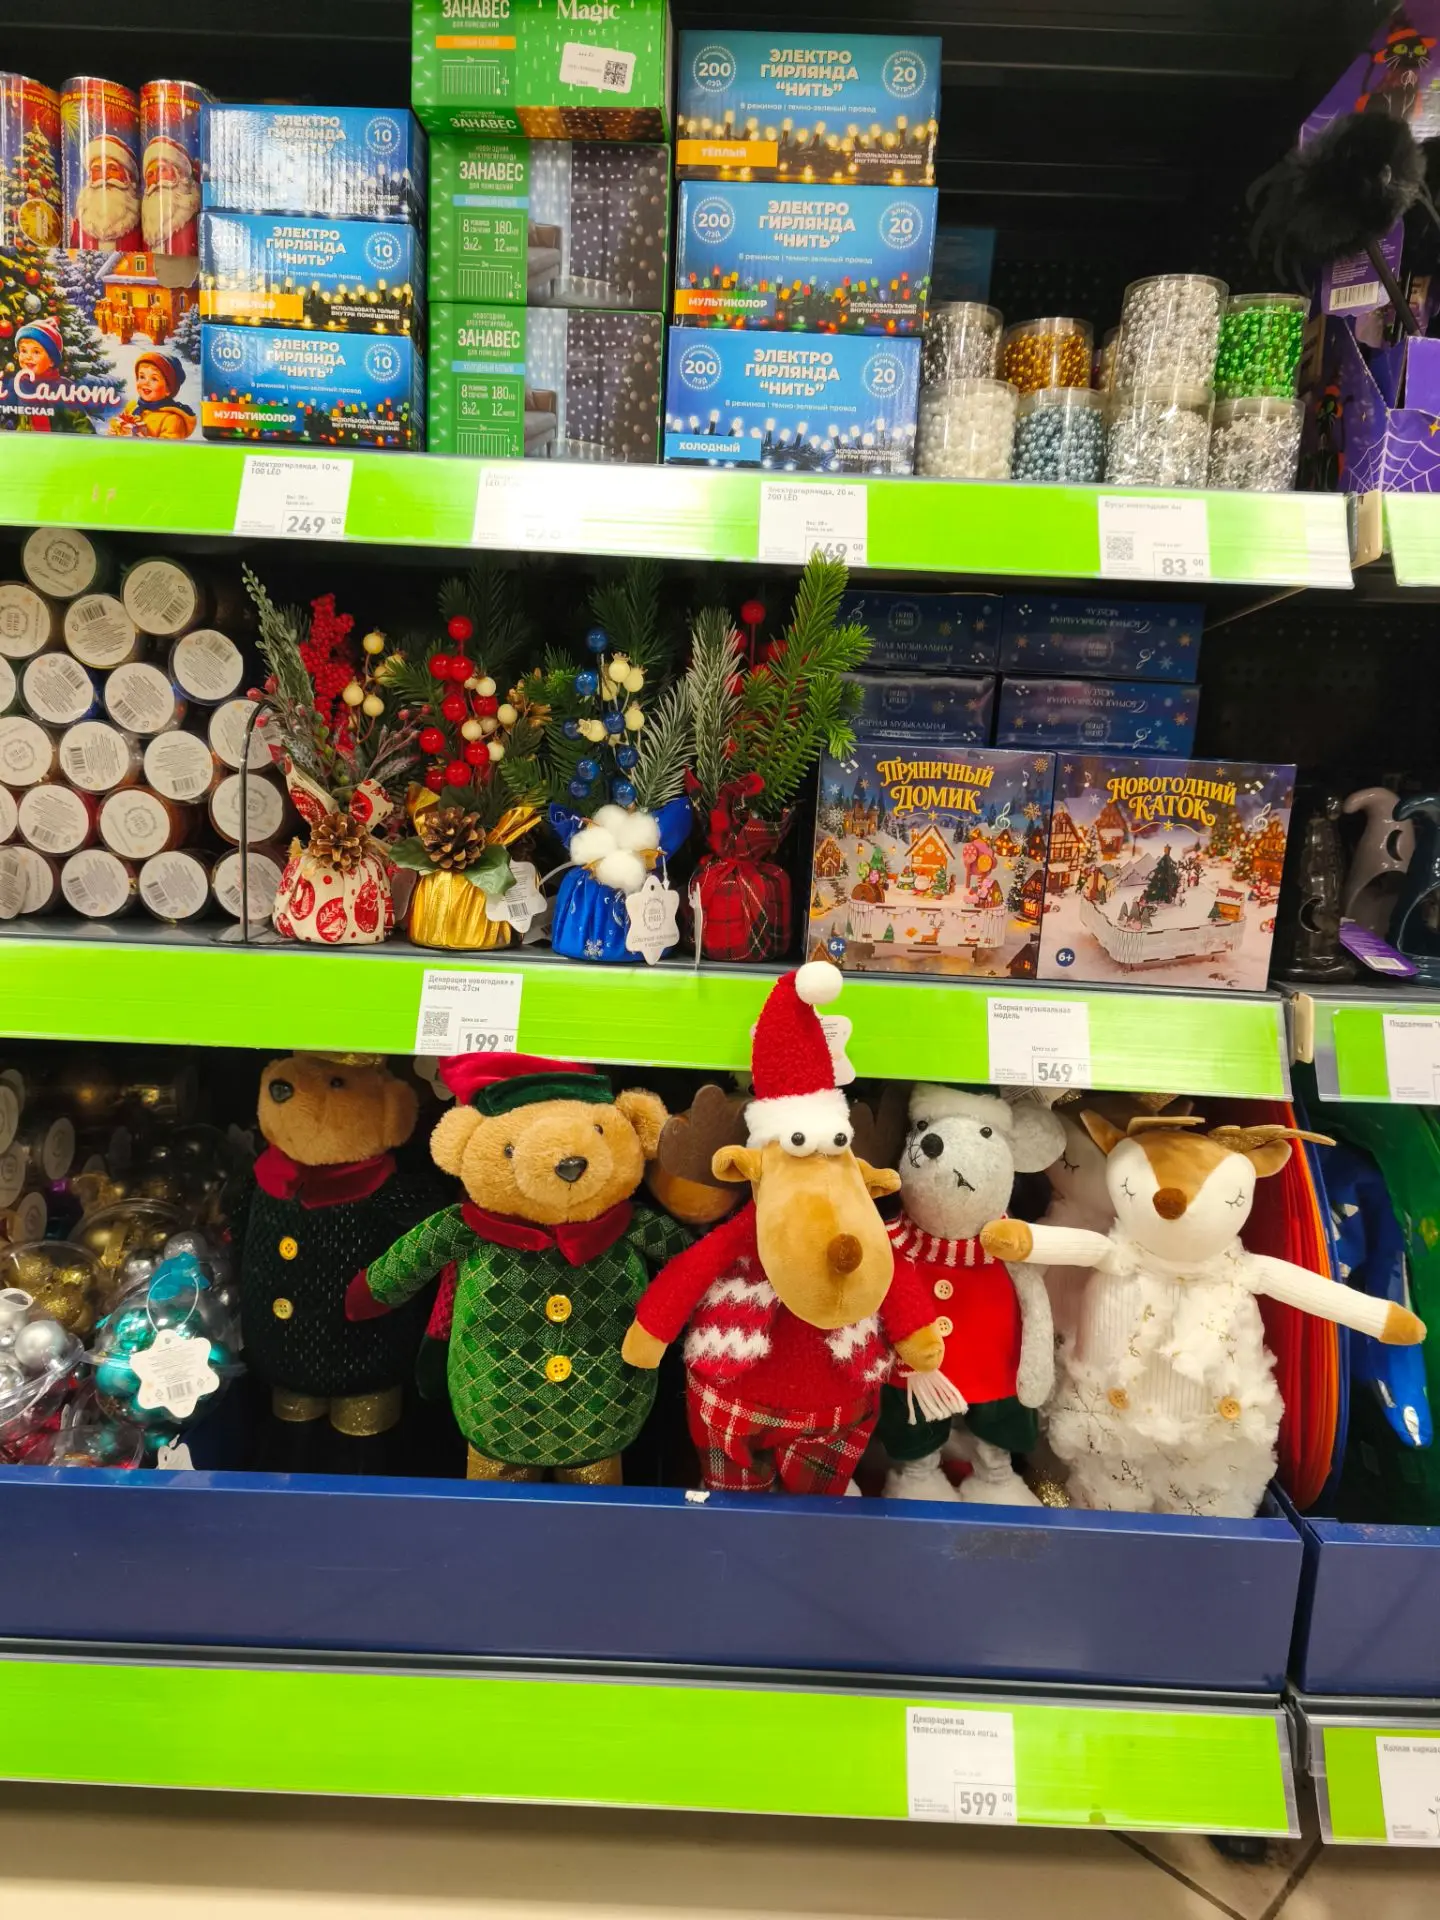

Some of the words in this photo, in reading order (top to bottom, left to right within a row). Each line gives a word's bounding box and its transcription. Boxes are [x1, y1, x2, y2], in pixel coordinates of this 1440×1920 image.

[442, 0, 510, 18] ЗАНАВЕС
[556, 0, 620, 25] Magic
[769, 48, 852, 65] ЭЛЕКТРО
[698, 62, 731, 77] 200
[760, 63, 859, 81] ГИРЛЯНДА
[892, 66, 917, 82] 20
[274, 115, 340, 128] ЭЛЕКТРО
[449, 118, 517, 129] ЗАНАВЕС
[374, 129, 392, 142] 10
[459, 160, 524, 181] ЗАНАВЕС
[767, 200, 849, 216] ЭЛЕКТРО
[463, 218, 469, 233] 8
[494, 220, 512, 235] 180
[698, 213, 731, 228] 200
[759, 215, 856, 233] ГИРЛЯНДА
[890, 218, 914, 234] 20
[273, 227, 340, 240] ЭЛЕКТРО
[266, 239, 346, 254] ГИРЛЯНДА
[374, 244, 392, 257] 10
[494, 237, 505, 252] 12
[688, 297, 768, 309] МУЛЬТИКОЛОР
[273, 339, 340, 353] ЭЛЕКТРО
[457, 328, 520, 348] ЗАНАВЕС
[215, 347, 241, 359] 100
[266, 351, 346, 366] ГИРЛЯНДА
[754, 349, 833, 365] ЭЛЕКТРО
[373, 357, 392, 370] 10
[685, 360, 717, 375] 200
[745, 363, 841, 382] ГИРЛЯНДА
[872, 367, 896, 384] 20
[14, 368, 121, 405] Салют
[461, 384, 467, 398] 8
[492, 385, 509, 400] 180
[214, 409, 296, 423] МУЛЬТИКОЛОР
[492, 402, 503, 416] 12
[679, 441, 740, 453] ХОЛОДНЫЙ
[287, 516, 325, 533] 249
[1162, 558, 1187, 576] 83
[876, 756, 995, 788] ПРЯНИЧНЫЙ
[1106, 776, 1237, 806] НОВОГОДНИЙ
[890, 785, 982, 817] ДОМИК
[1129, 795, 1216, 827] КАТОК
[830, 941, 845, 951] 6+
[1058, 952, 1073, 962] 6+
[465, 1033, 499, 1052] 199
[1038, 1062, 1073, 1082] 549
[960, 1791, 997, 1816] 599
